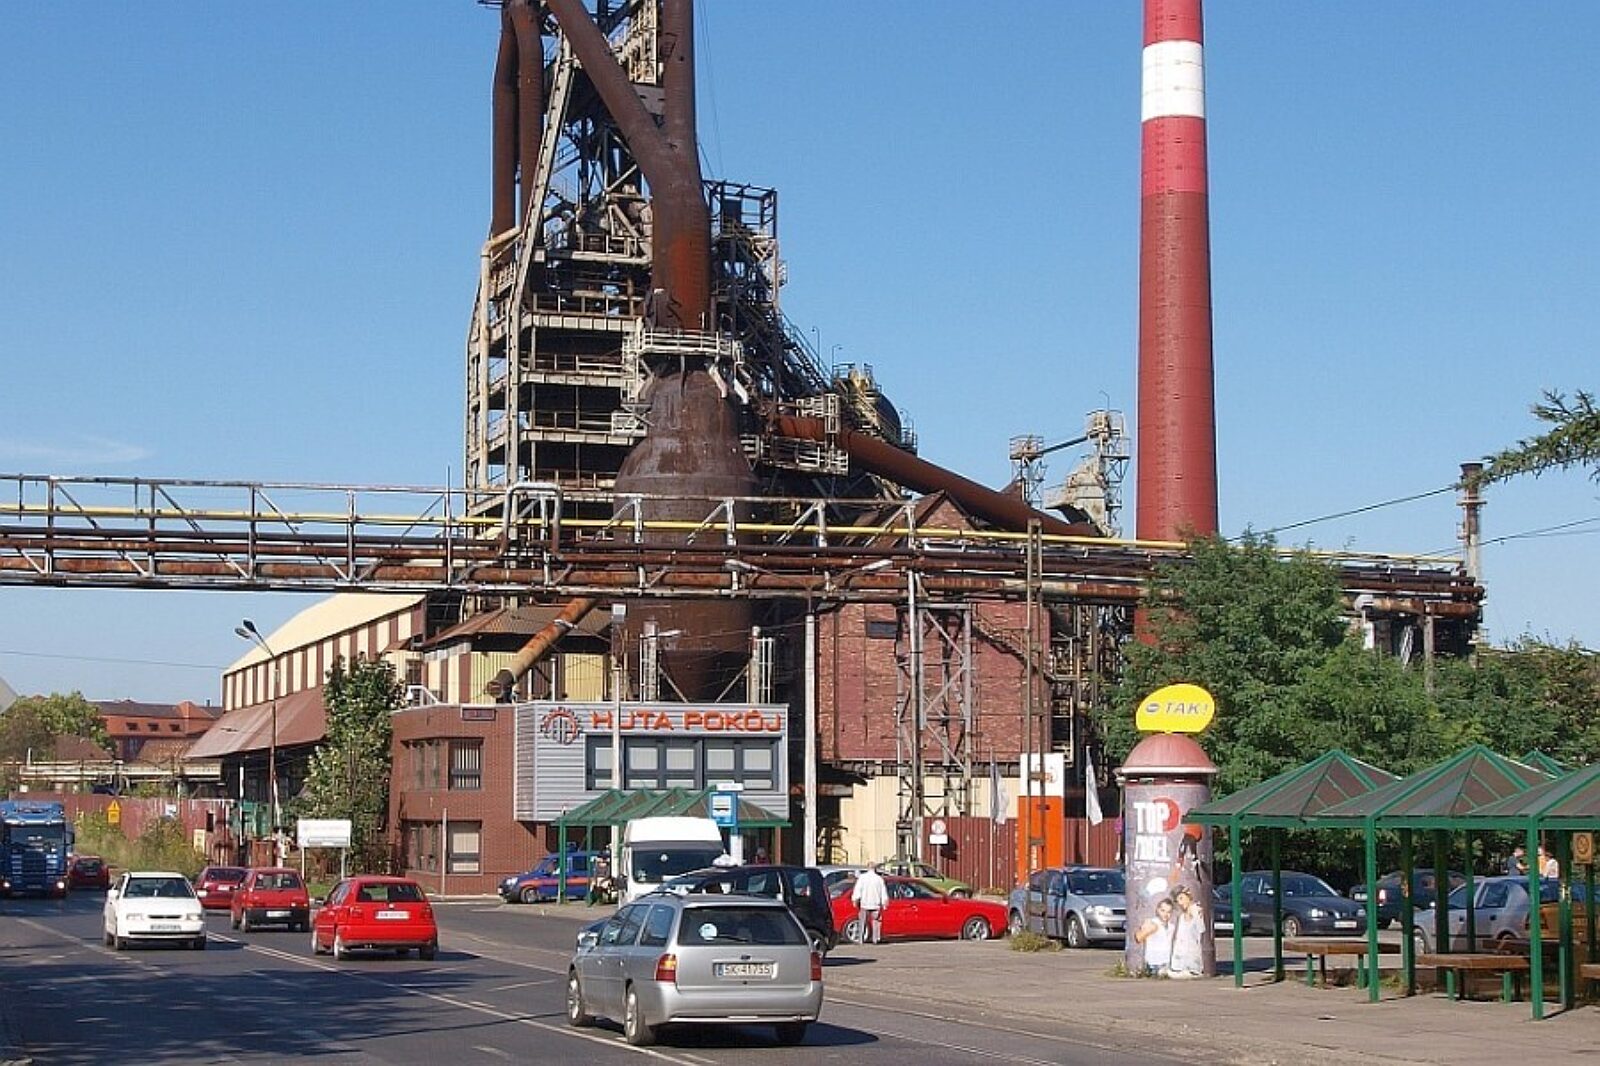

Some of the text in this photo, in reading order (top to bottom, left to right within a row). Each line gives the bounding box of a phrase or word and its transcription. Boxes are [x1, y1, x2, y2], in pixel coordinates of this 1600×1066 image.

[1165, 702, 1209, 715] TAK!
[683, 709, 782, 732] POKÓJ
[1133, 801, 1170, 834] TOP
